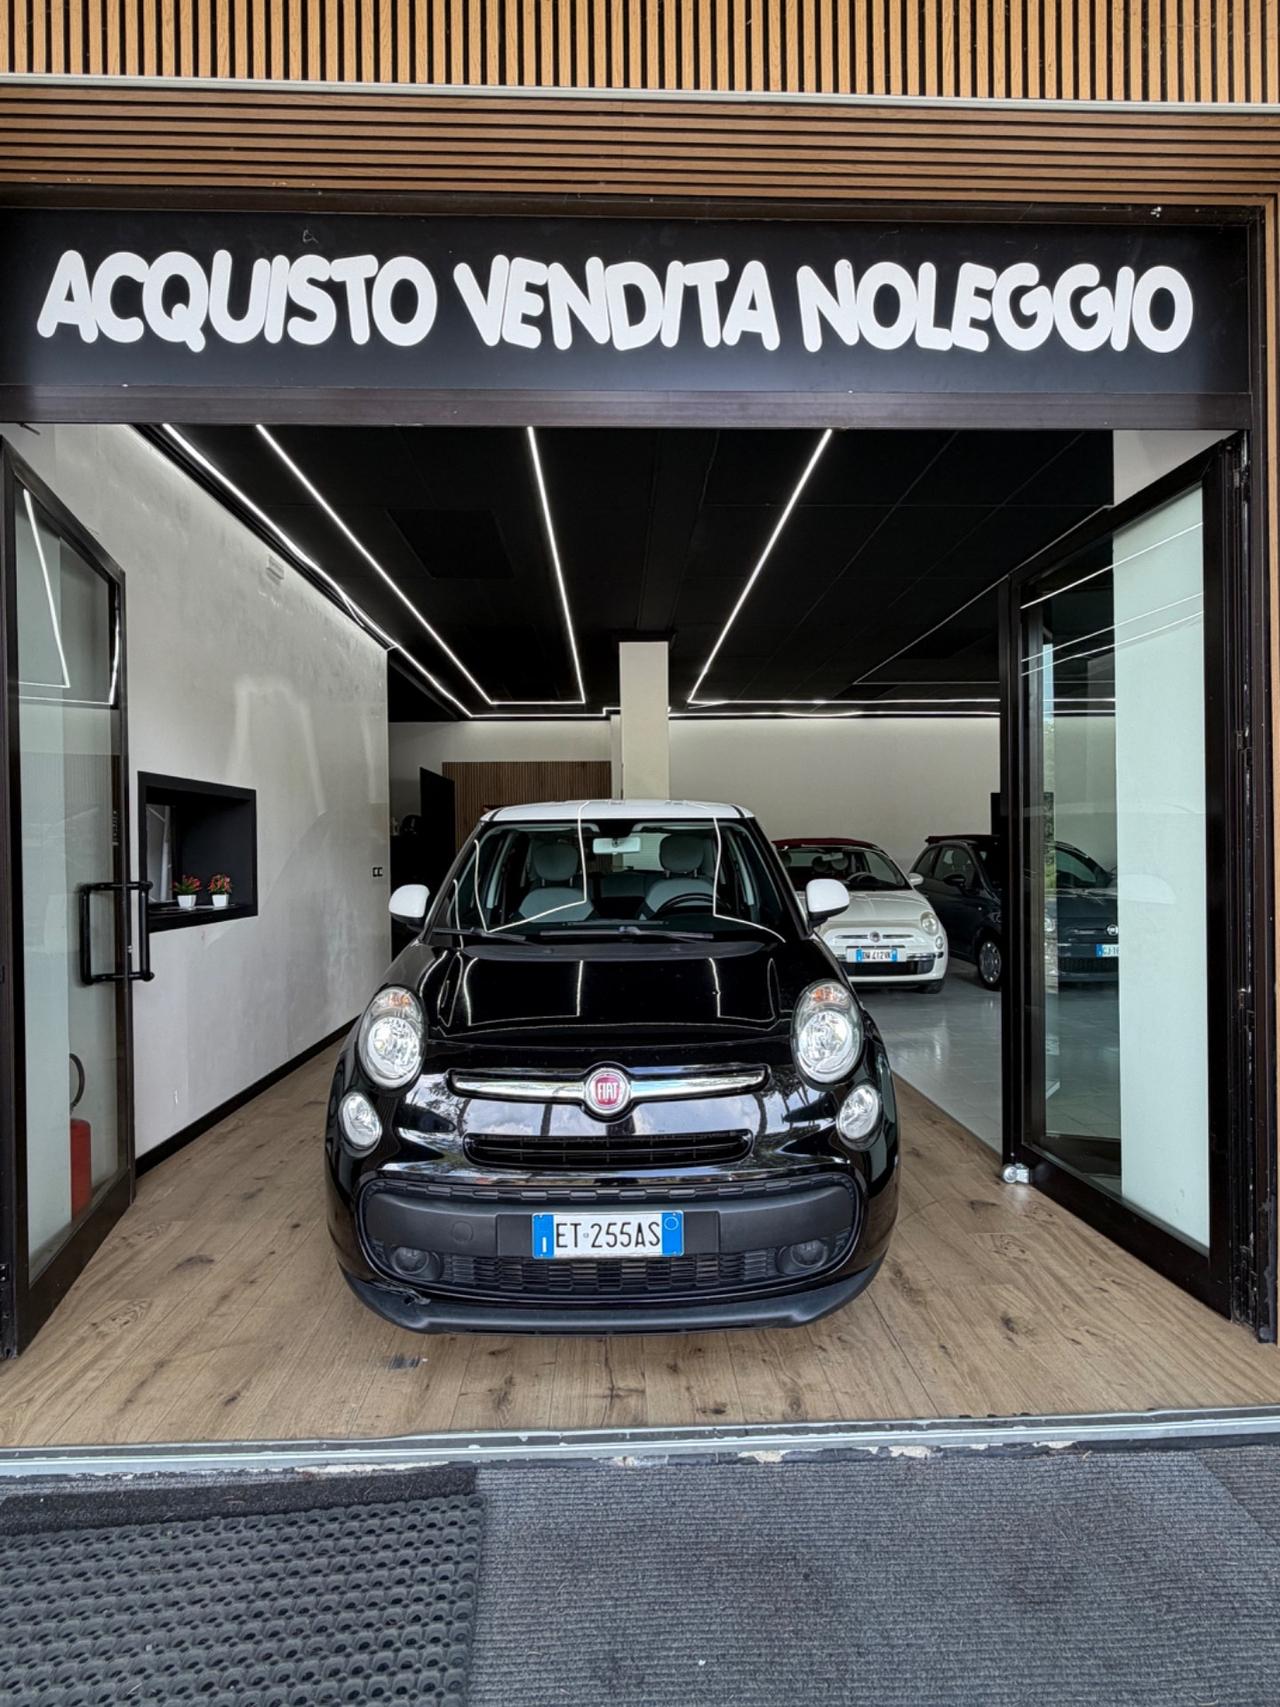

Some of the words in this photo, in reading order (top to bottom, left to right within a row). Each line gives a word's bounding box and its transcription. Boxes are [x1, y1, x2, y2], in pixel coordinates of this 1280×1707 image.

[37, 250, 438, 352] ACQUISTO
[454, 255, 780, 351] VENDITA
[797, 259, 1194, 353] NOLEGGIO
[597, 1082, 619, 1102] FIAT
[555, 1222, 582, 1248] ET
[590, 1221, 661, 1249] 255AS
